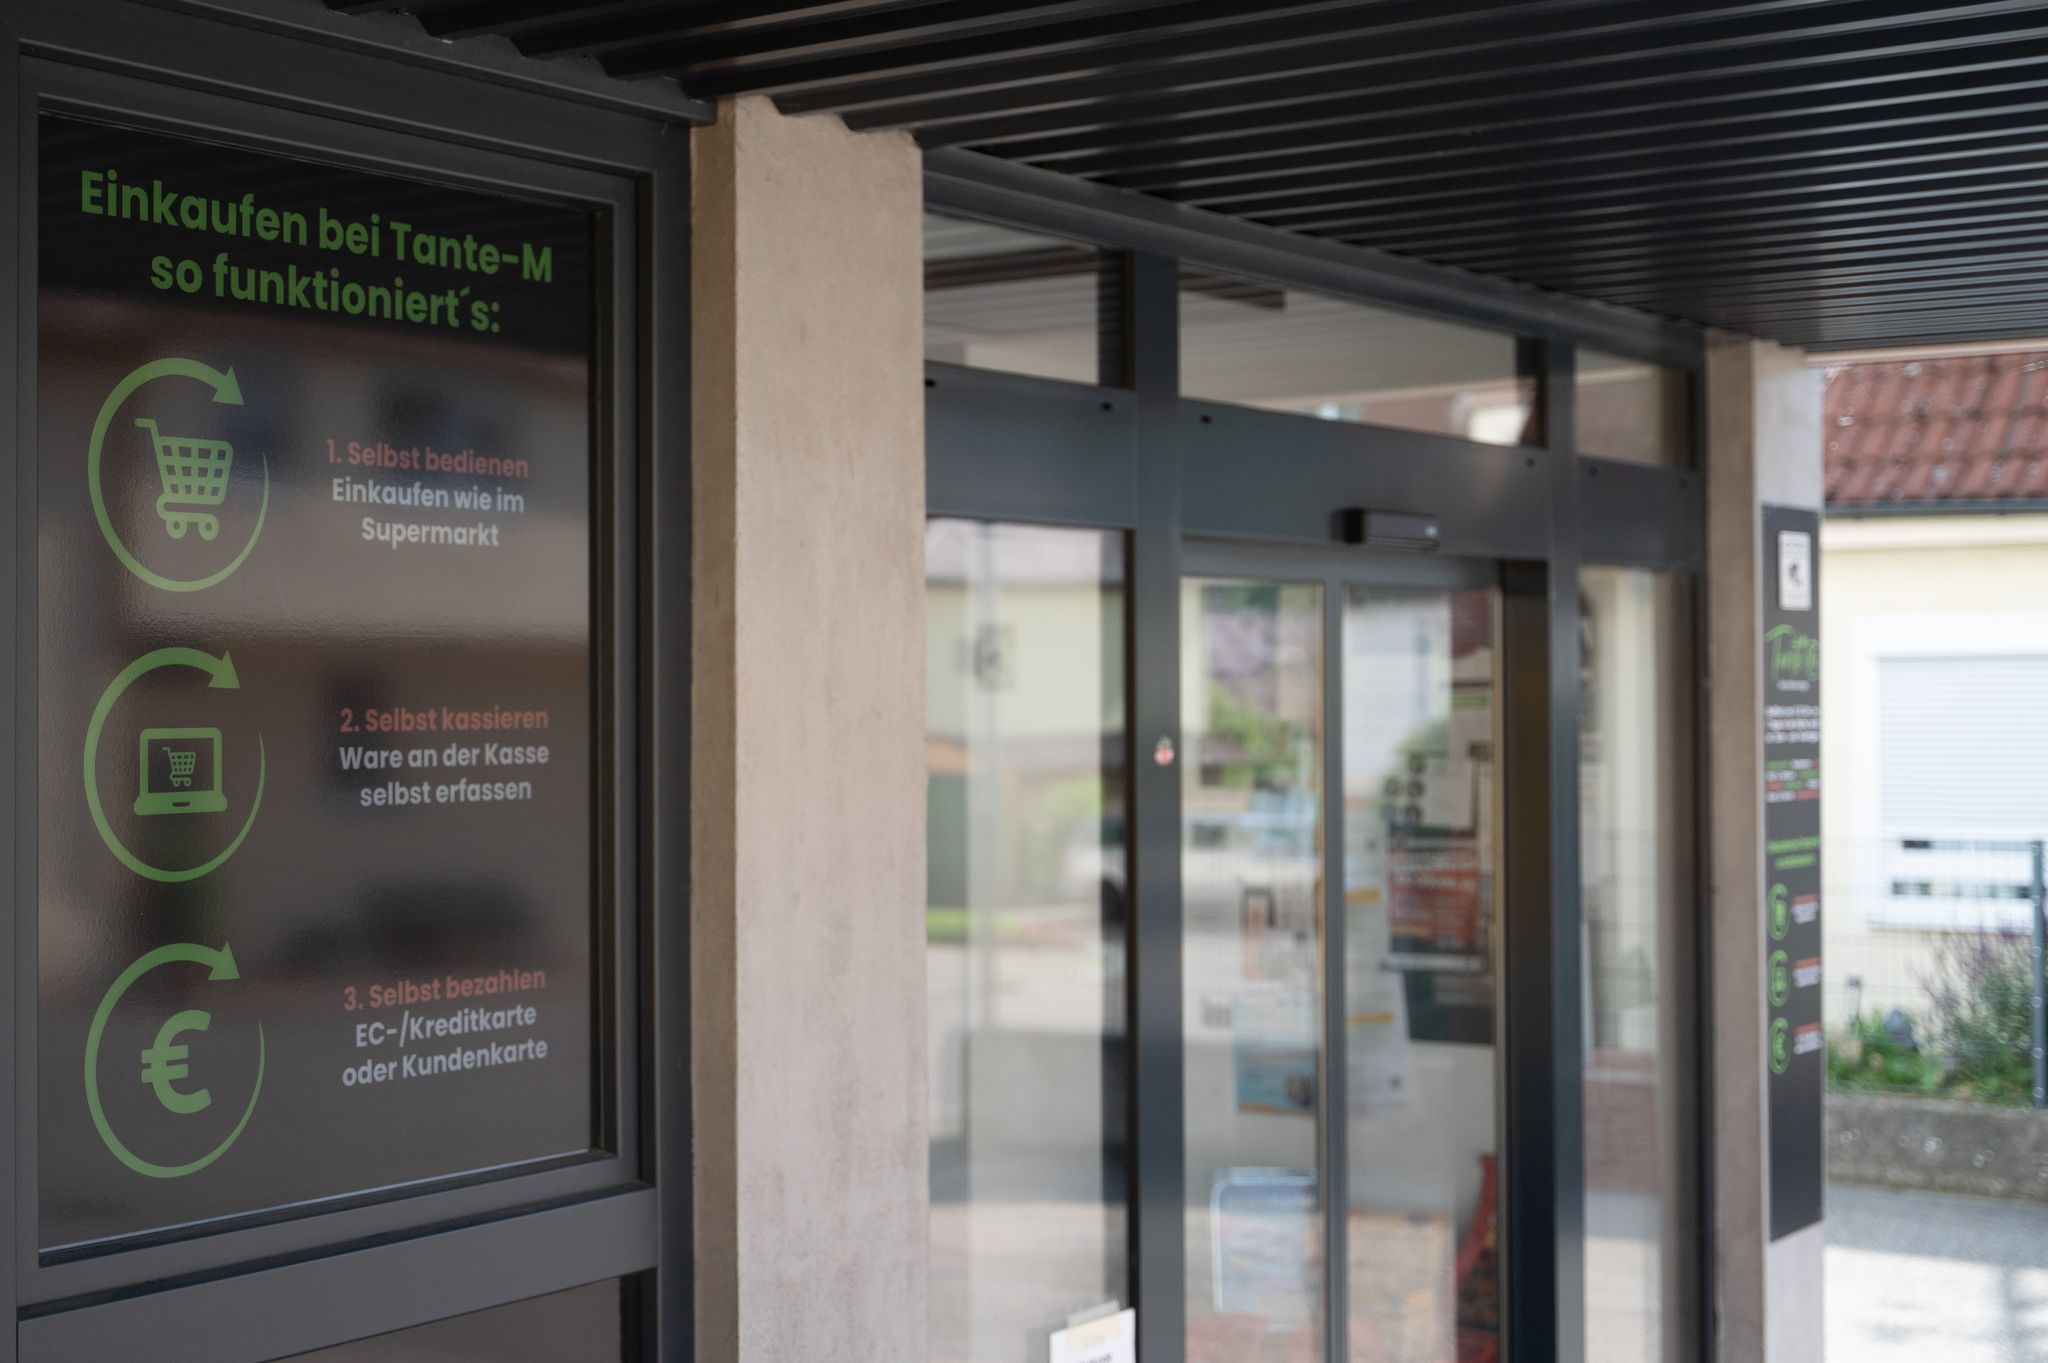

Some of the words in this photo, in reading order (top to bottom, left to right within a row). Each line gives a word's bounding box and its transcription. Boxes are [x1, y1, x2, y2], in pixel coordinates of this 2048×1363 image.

[81, 169, 308, 246] Einkaufen
[319, 208, 381, 257] bei
[390, 221, 553, 283] Tante-M
[150, 255, 203, 292] so
[326, 440, 343, 464] 1.
[348, 441, 421, 470] Selbst
[425, 448, 529, 478] bedienen
[331, 476, 450, 509] Einkaufen
[454, 484, 492, 510] wie
[496, 487, 525, 512] im
[361, 517, 500, 549] Supermarkt
[340, 708, 360, 733] 2.
[365, 707, 437, 732] Selbst
[441, 705, 549, 730] kassieren
[339, 746, 403, 770] Ware
[408, 749, 436, 769] an
[443, 743, 480, 769] der
[484, 743, 550, 766] Kasse
[360, 780, 431, 806] selbst
[436, 777, 532, 804] erfassen
[343, 987, 364, 1012] 3.
[369, 980, 441, 1009] Selbst
[446, 968, 546, 1000] bezahlen
[356, 1005, 537, 1048] EC-/Kreditkarte
[342, 1060, 398, 1087] oder
[402, 1038, 548, 1078] Kundenkarte
